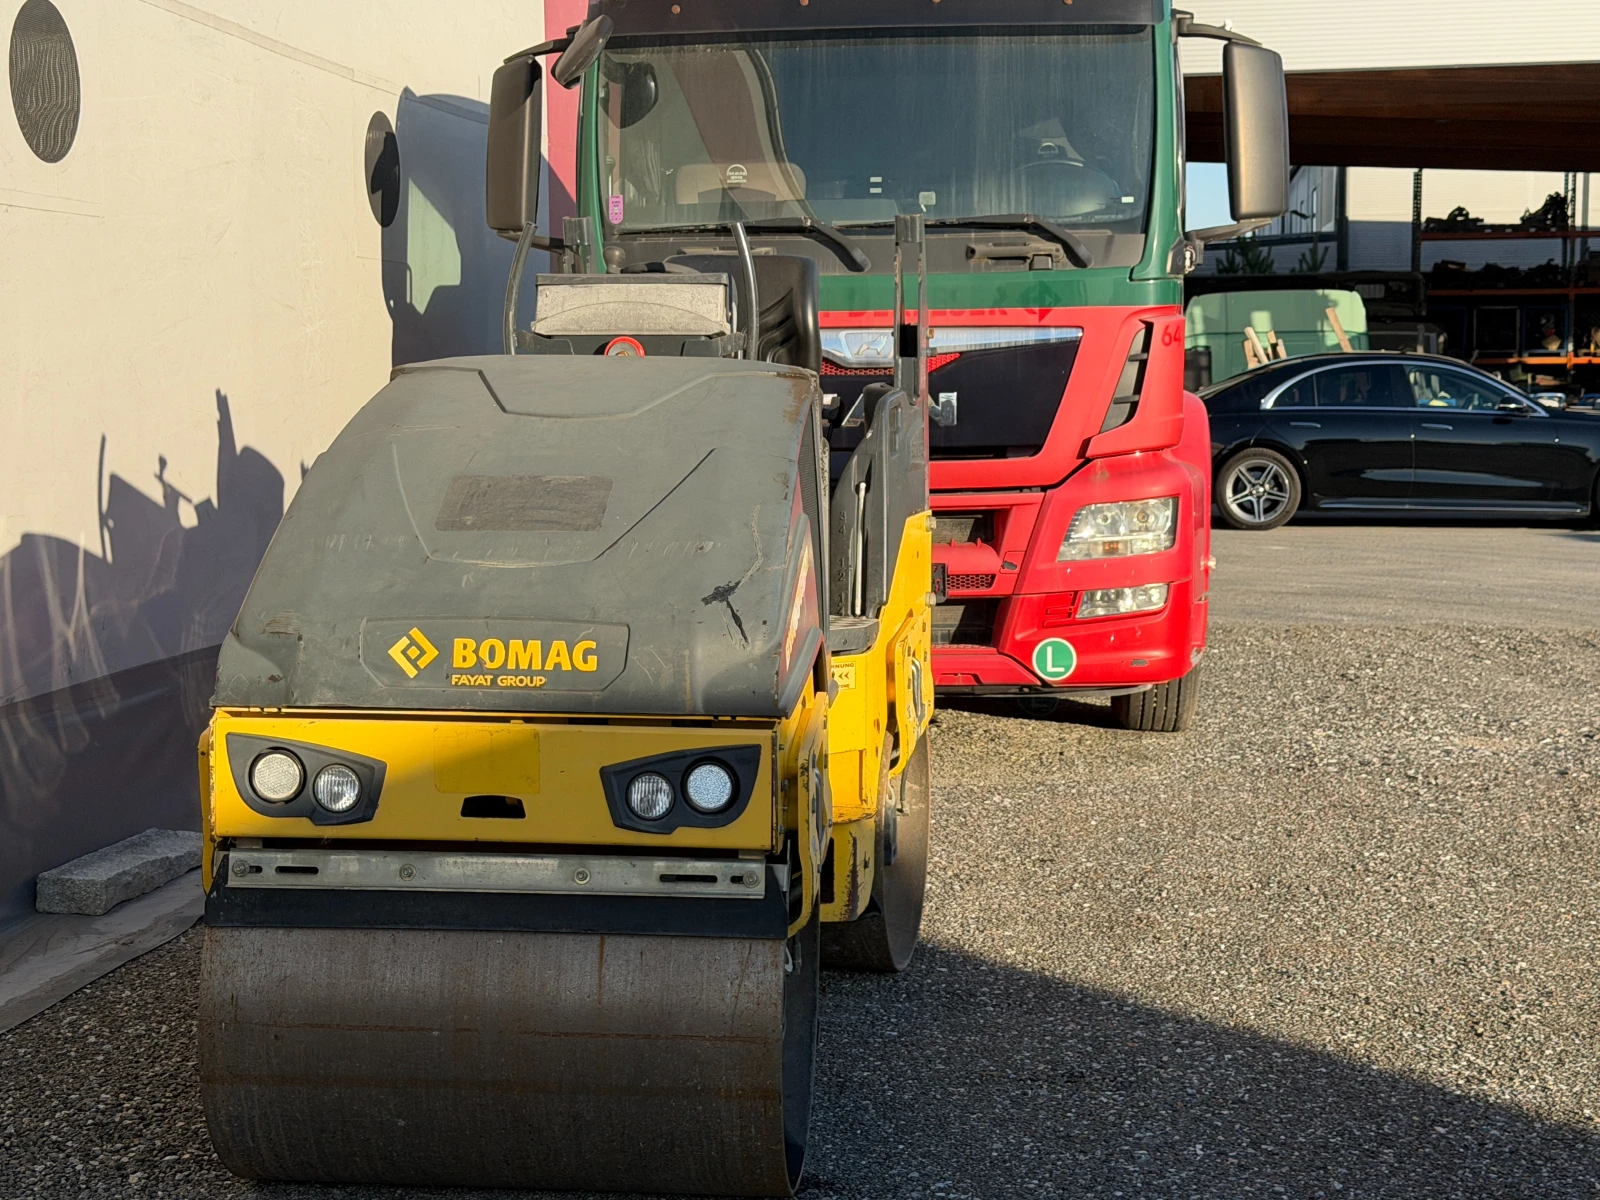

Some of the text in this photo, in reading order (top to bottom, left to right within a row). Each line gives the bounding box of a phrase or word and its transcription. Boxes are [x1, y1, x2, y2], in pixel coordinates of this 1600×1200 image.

[1161, 325, 1181, 347] 64
[452, 638, 598, 672] BOMAG
[1046, 645, 1065, 673] L
[451, 674, 547, 687] FAYAT GROUP
